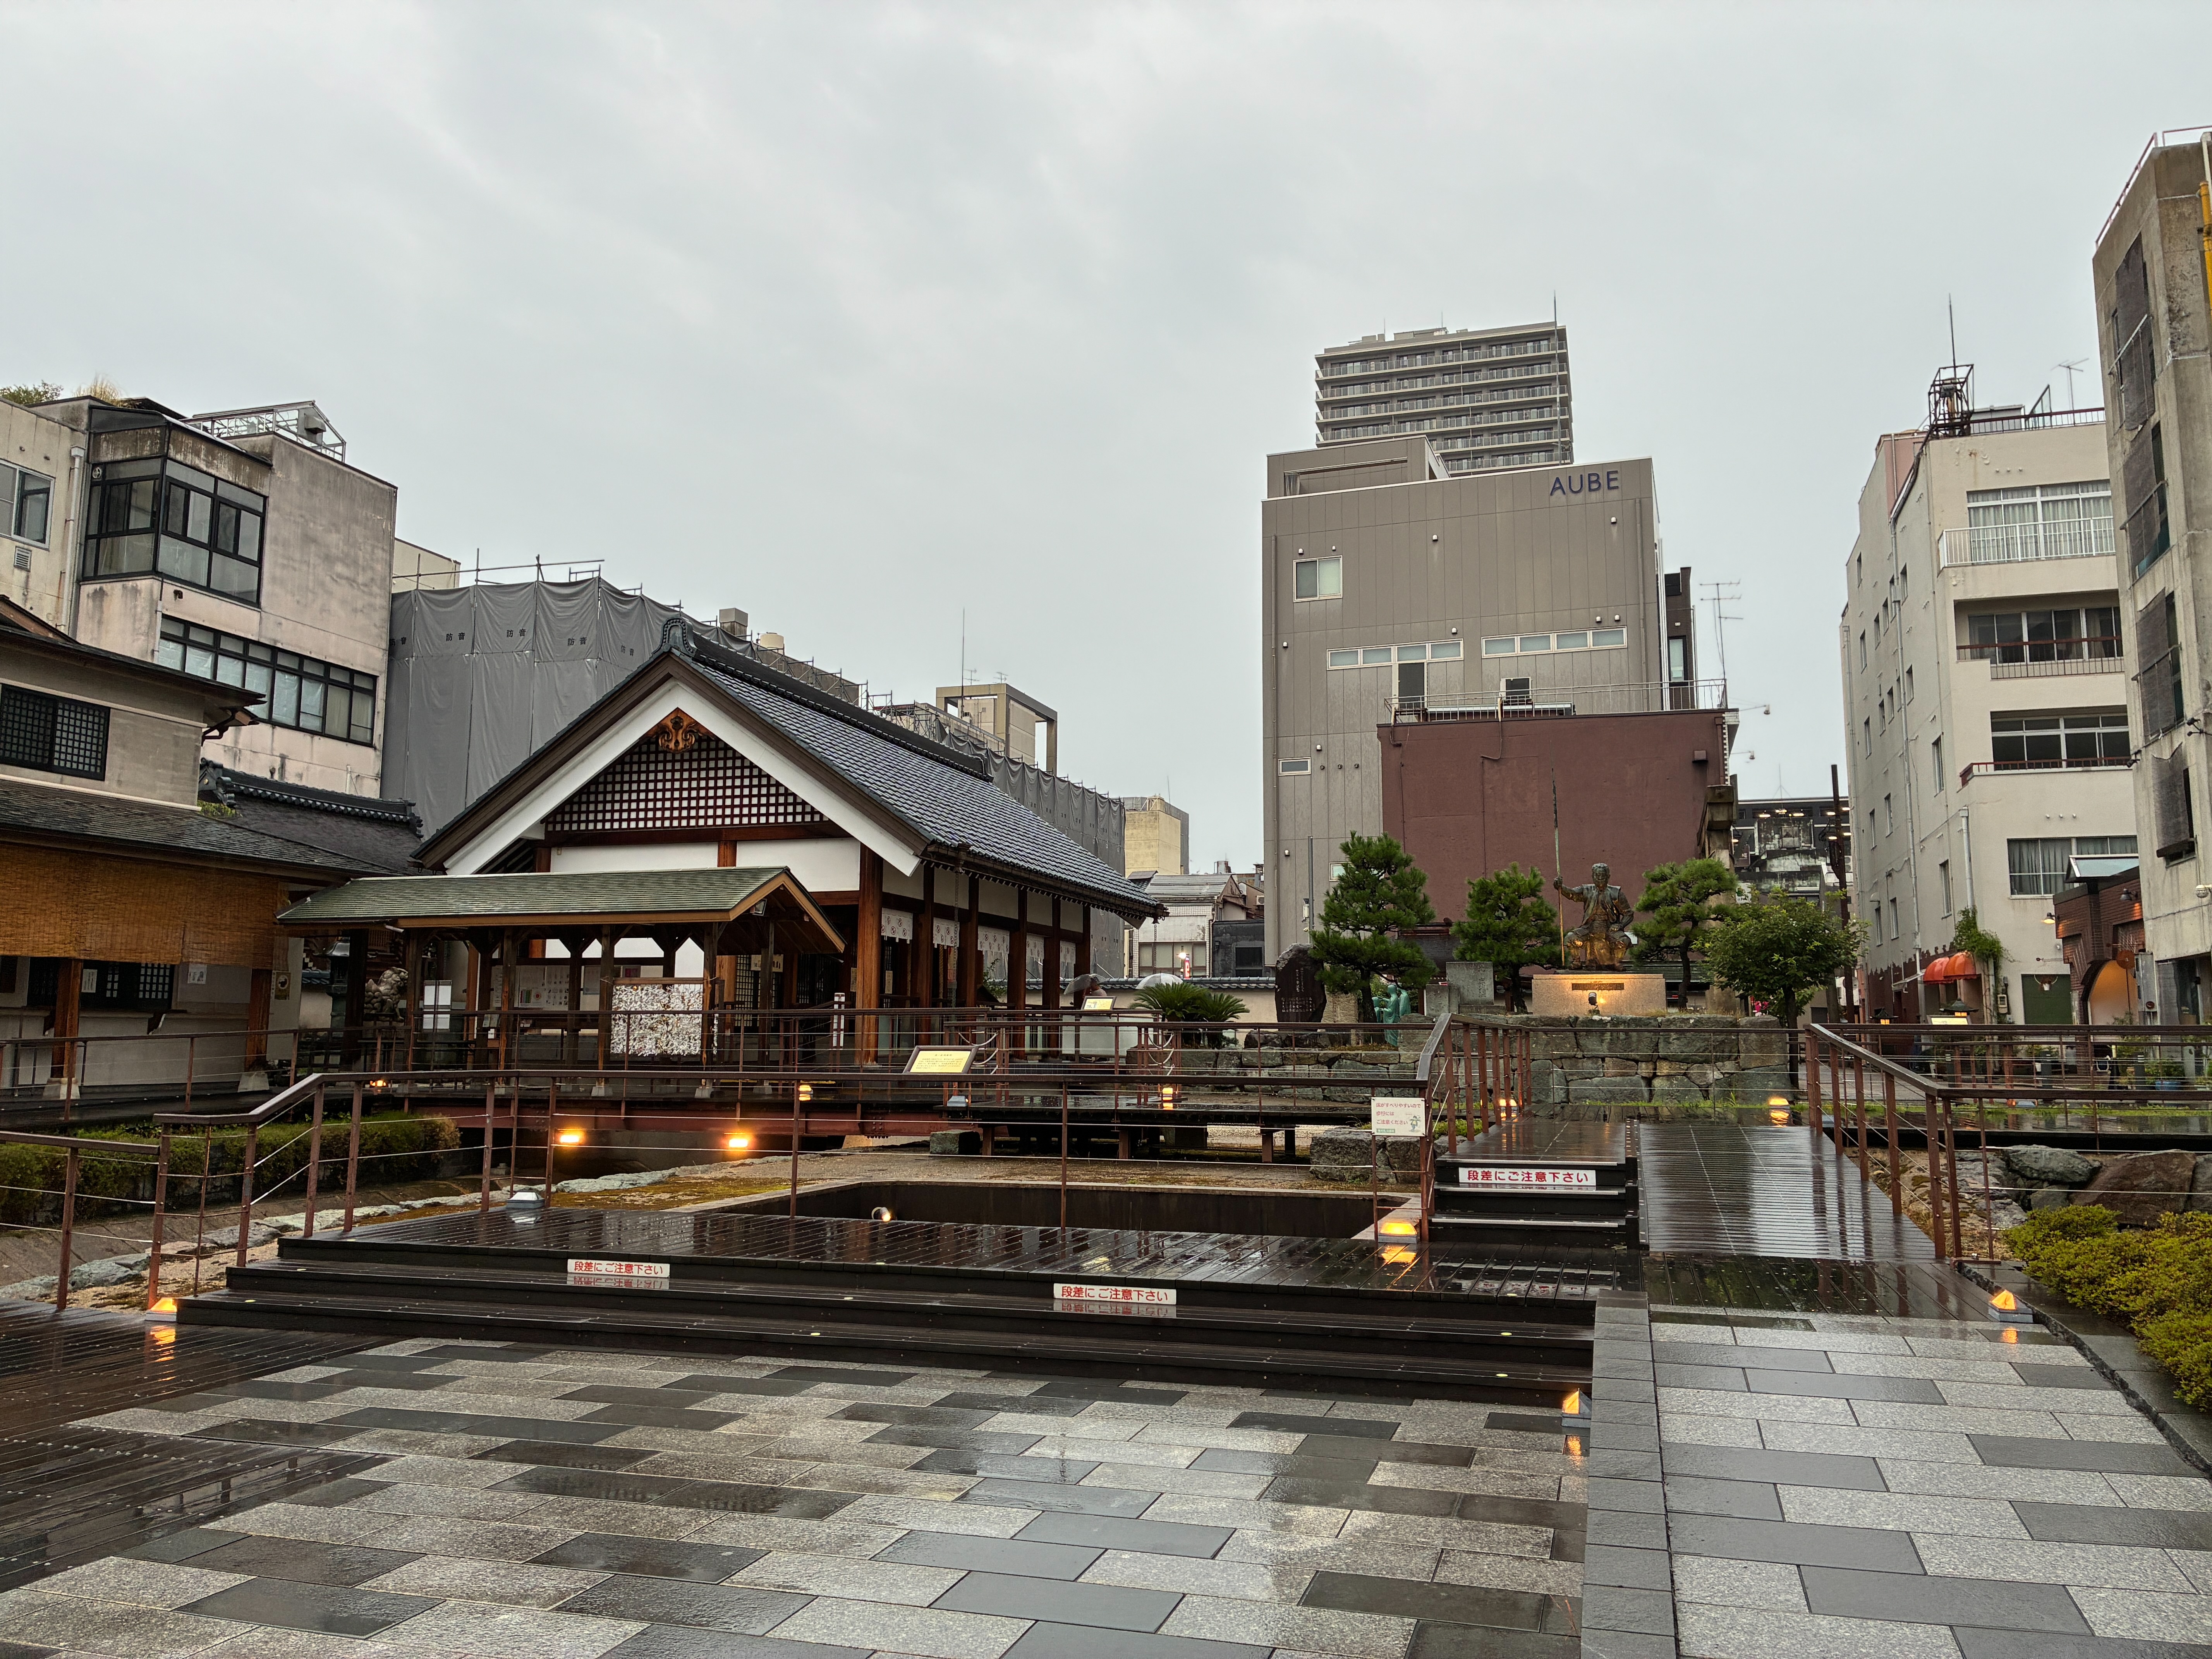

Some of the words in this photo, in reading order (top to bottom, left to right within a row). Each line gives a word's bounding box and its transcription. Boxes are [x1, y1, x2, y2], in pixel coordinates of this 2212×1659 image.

[1550, 470, 1619, 496] AUBE
[1467, 1170, 1589, 1183] 段差にご注意下さい
